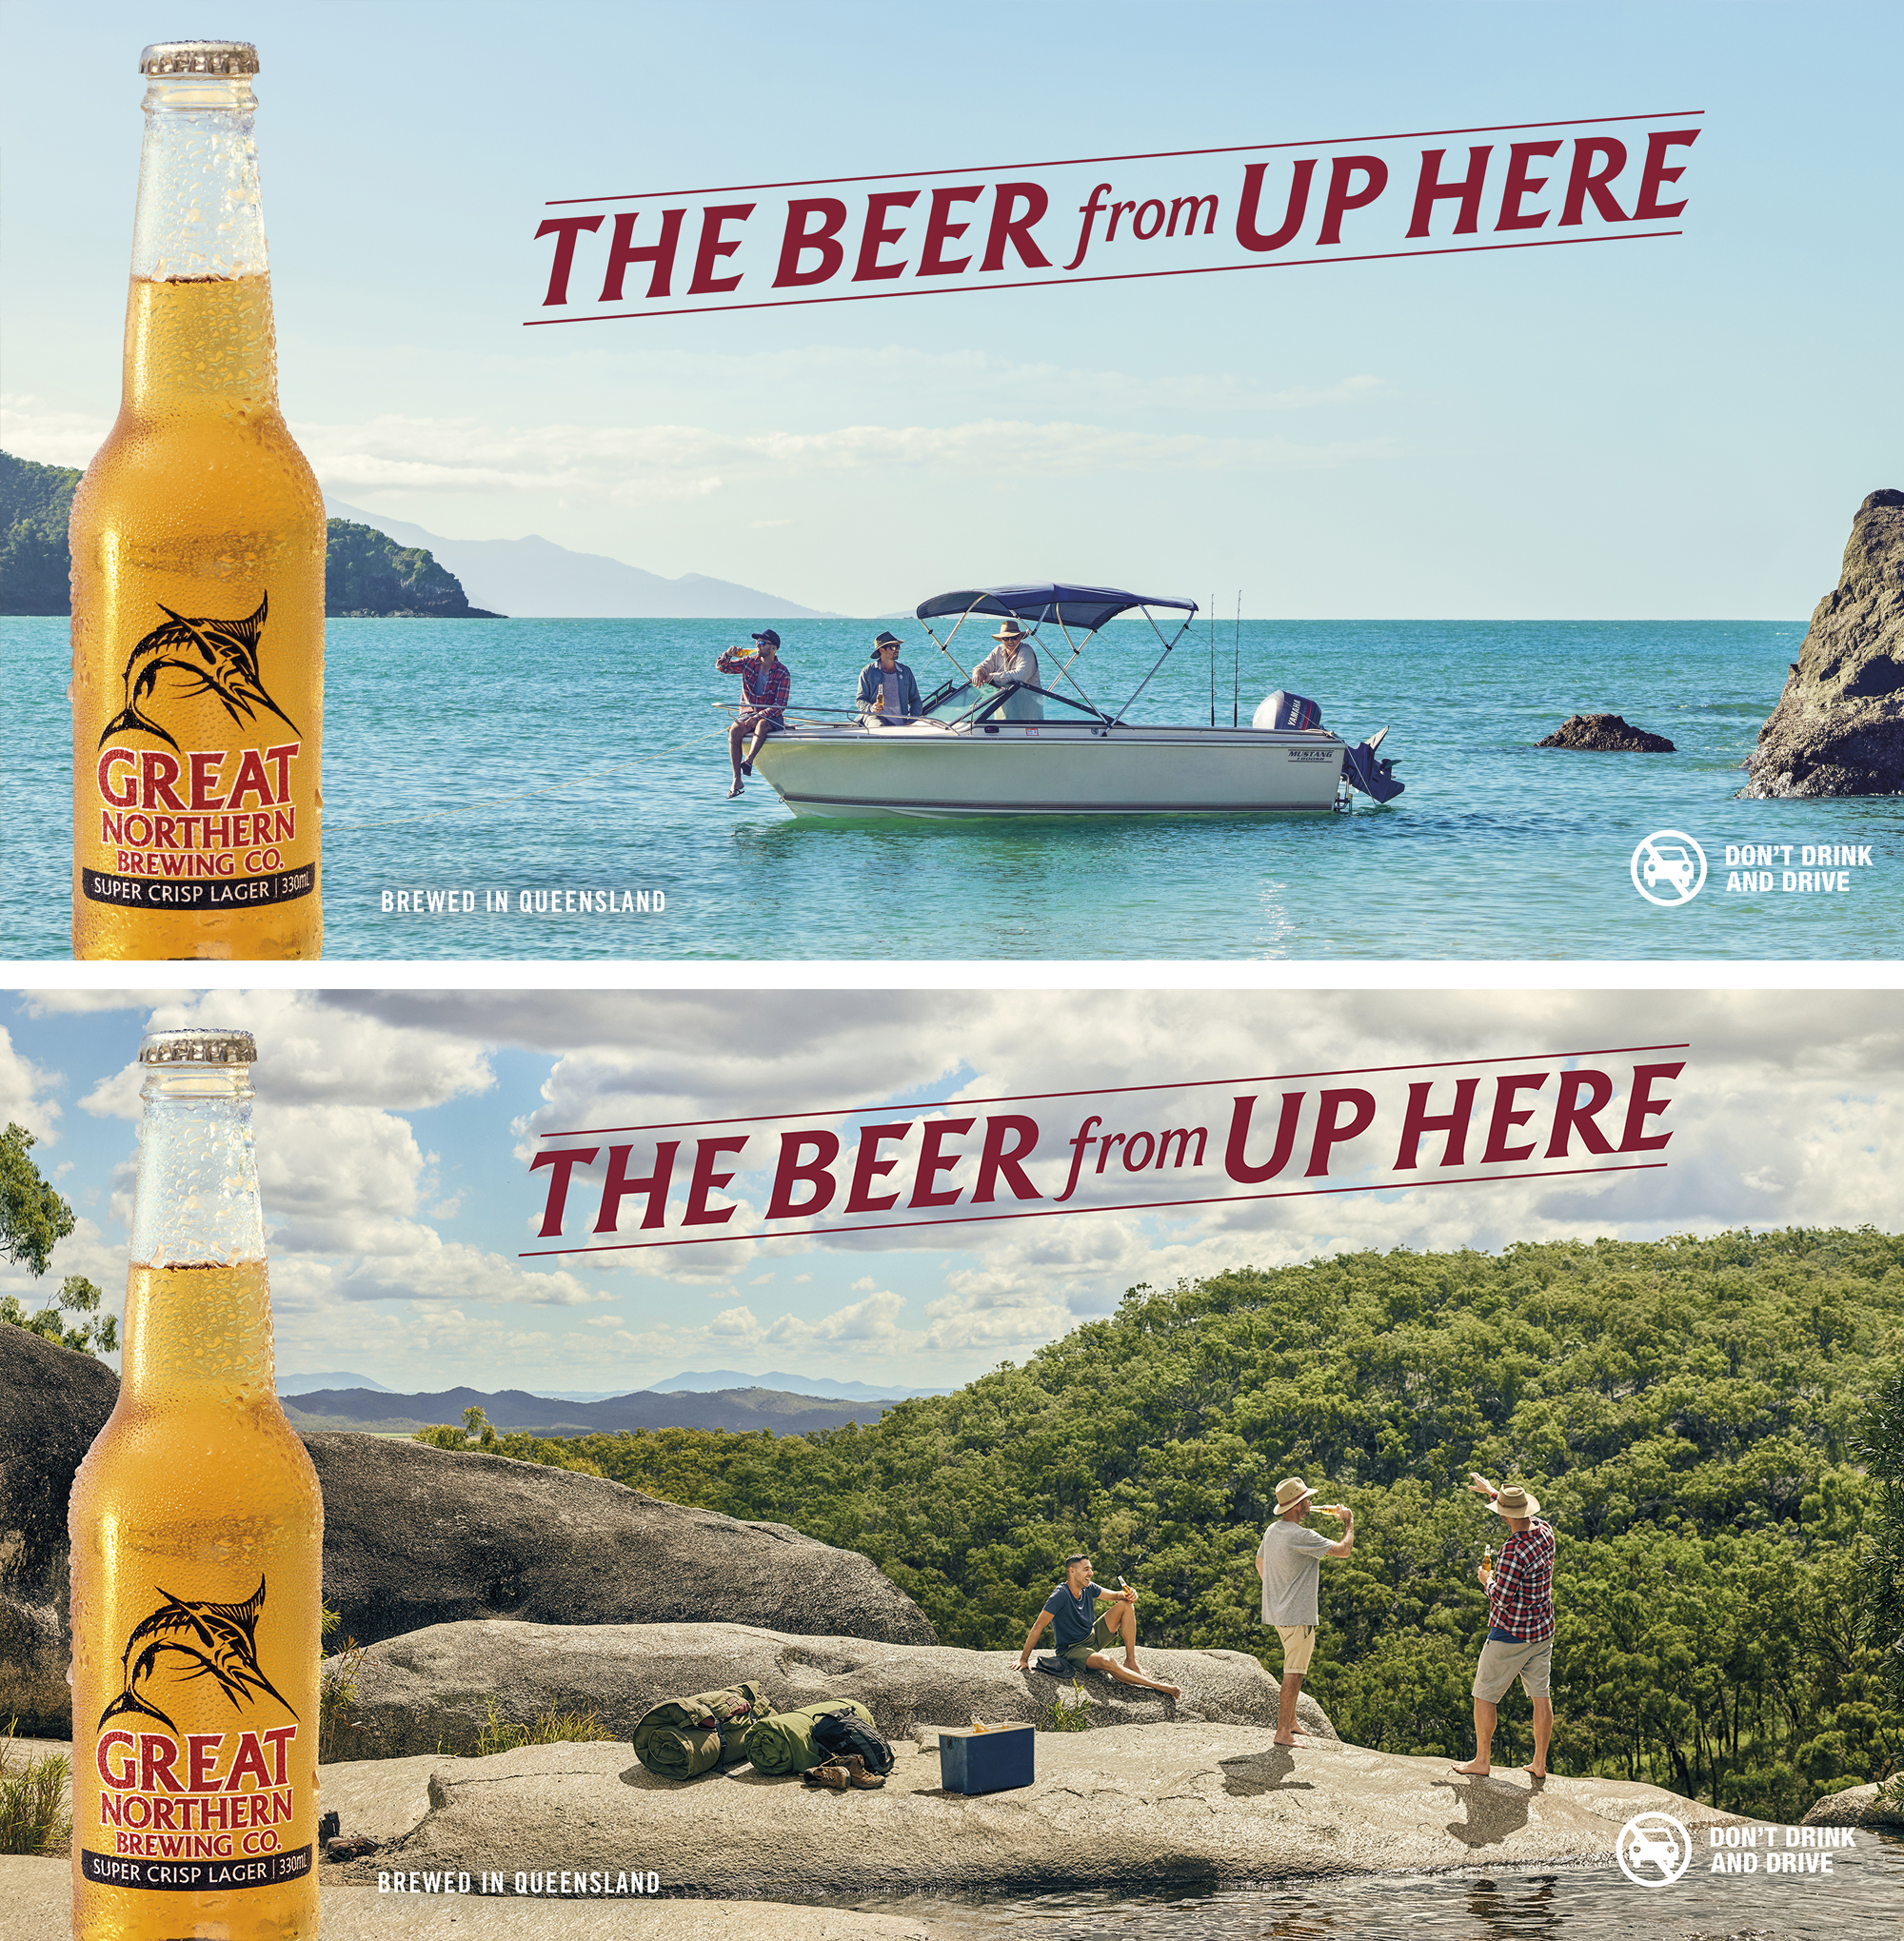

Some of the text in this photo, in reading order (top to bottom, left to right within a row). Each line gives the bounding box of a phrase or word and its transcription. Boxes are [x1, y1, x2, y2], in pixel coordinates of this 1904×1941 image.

[1288, 700, 1300, 726] YAMAHA
[97, 743, 301, 812] GREAT
[100, 807, 296, 849] NORTHERN
[116, 846, 286, 876] BREWING CO.
[94, 873, 310, 902] SUPER CRISP LAGER 330mL
[96, 1724, 298, 1794] GREAT
[100, 1789, 293, 1832] NORTHERN
[115, 1829, 282, 1859] BREWING CO.
[93, 1854, 307, 1883] SUPER CRISP LAGER 330mL
